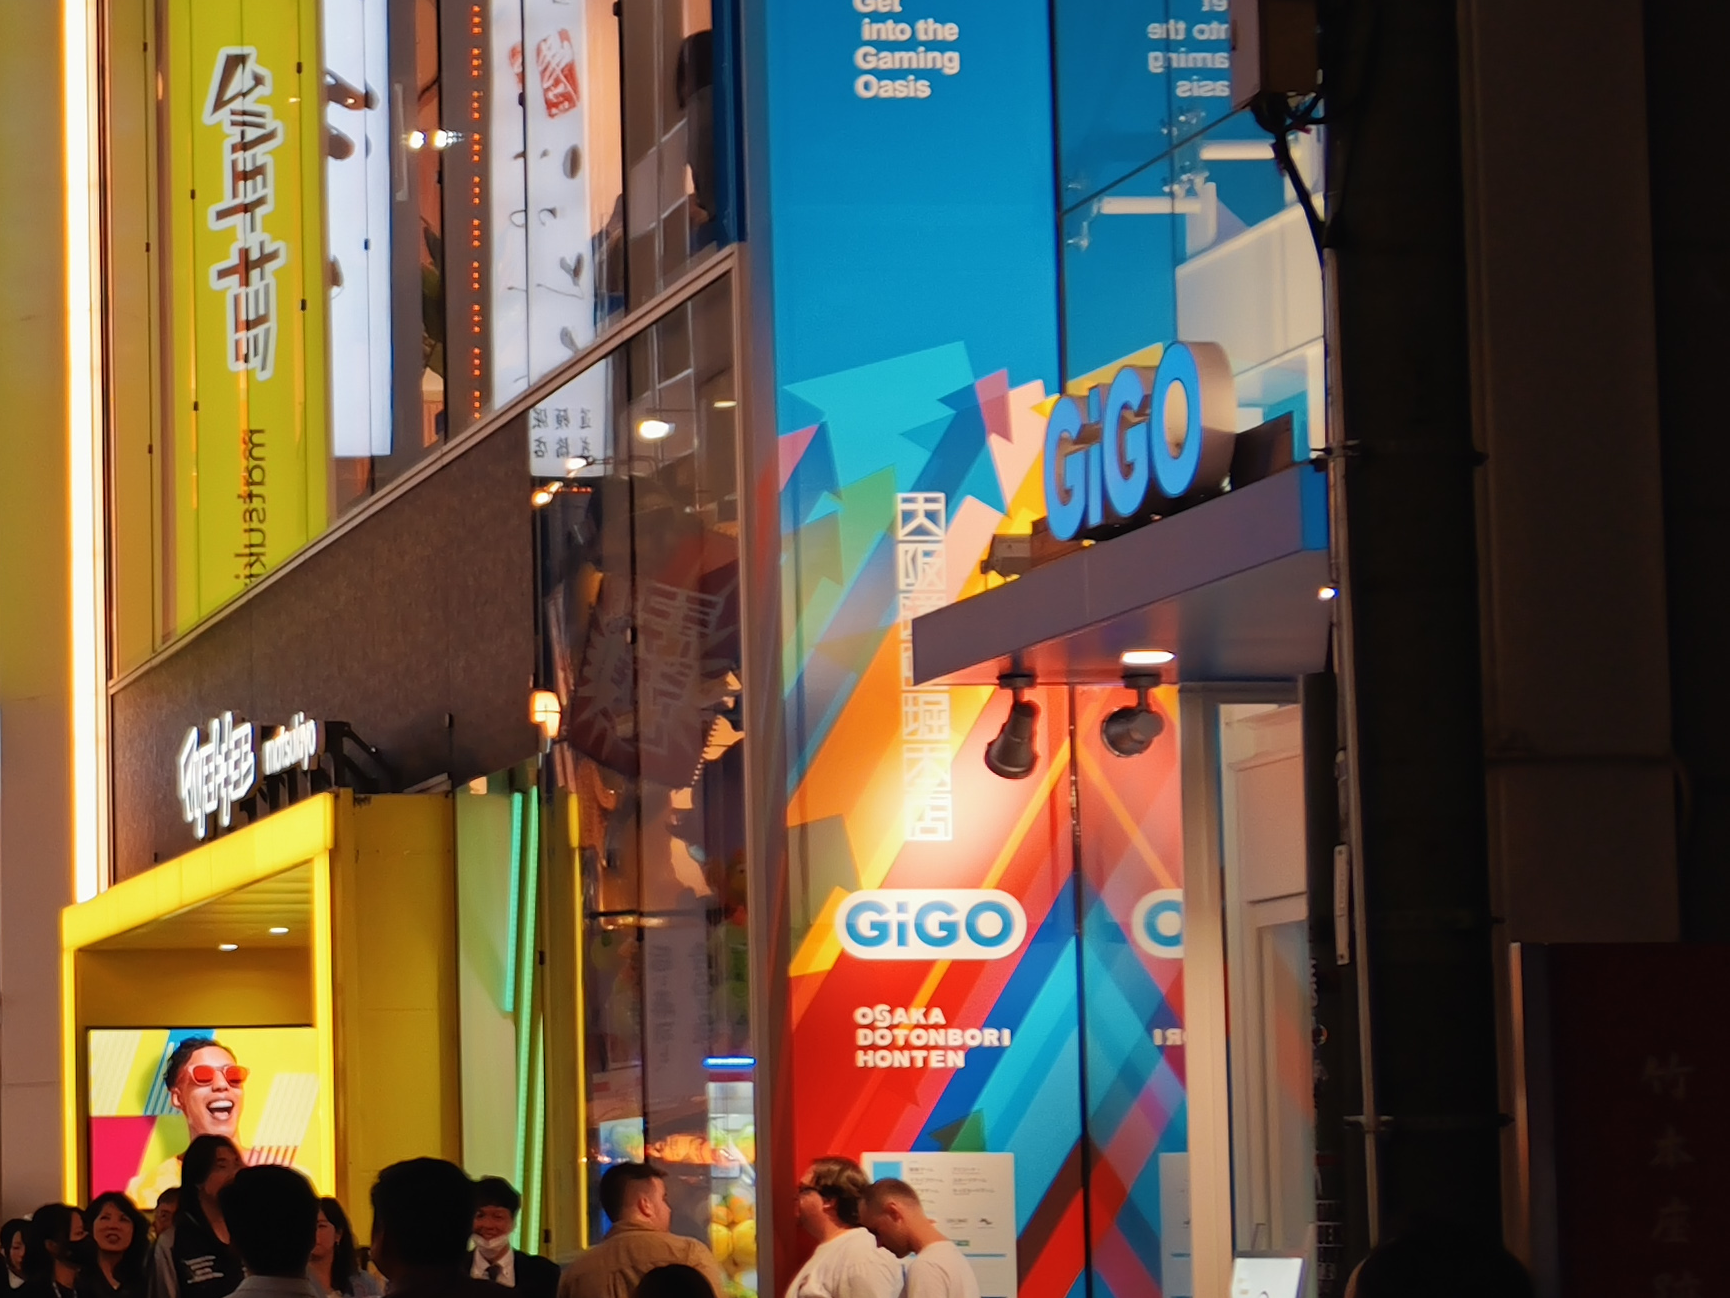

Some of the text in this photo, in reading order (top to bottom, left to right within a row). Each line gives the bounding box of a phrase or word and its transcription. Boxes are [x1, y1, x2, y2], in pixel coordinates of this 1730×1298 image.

[862, 19, 958, 42] into the
[854, 47, 960, 75] Gaming
[854, 76, 932, 98] Oasis
[1044, 341, 1202, 541] GiGO
[262, 711, 316, 775] matsukiyo
[846, 900, 1014, 949] GiGO
[854, 1003, 946, 1027] OSAKA
[856, 1027, 1011, 1048] DOTONBORI
[855, 1048, 966, 1069] HONTEN
